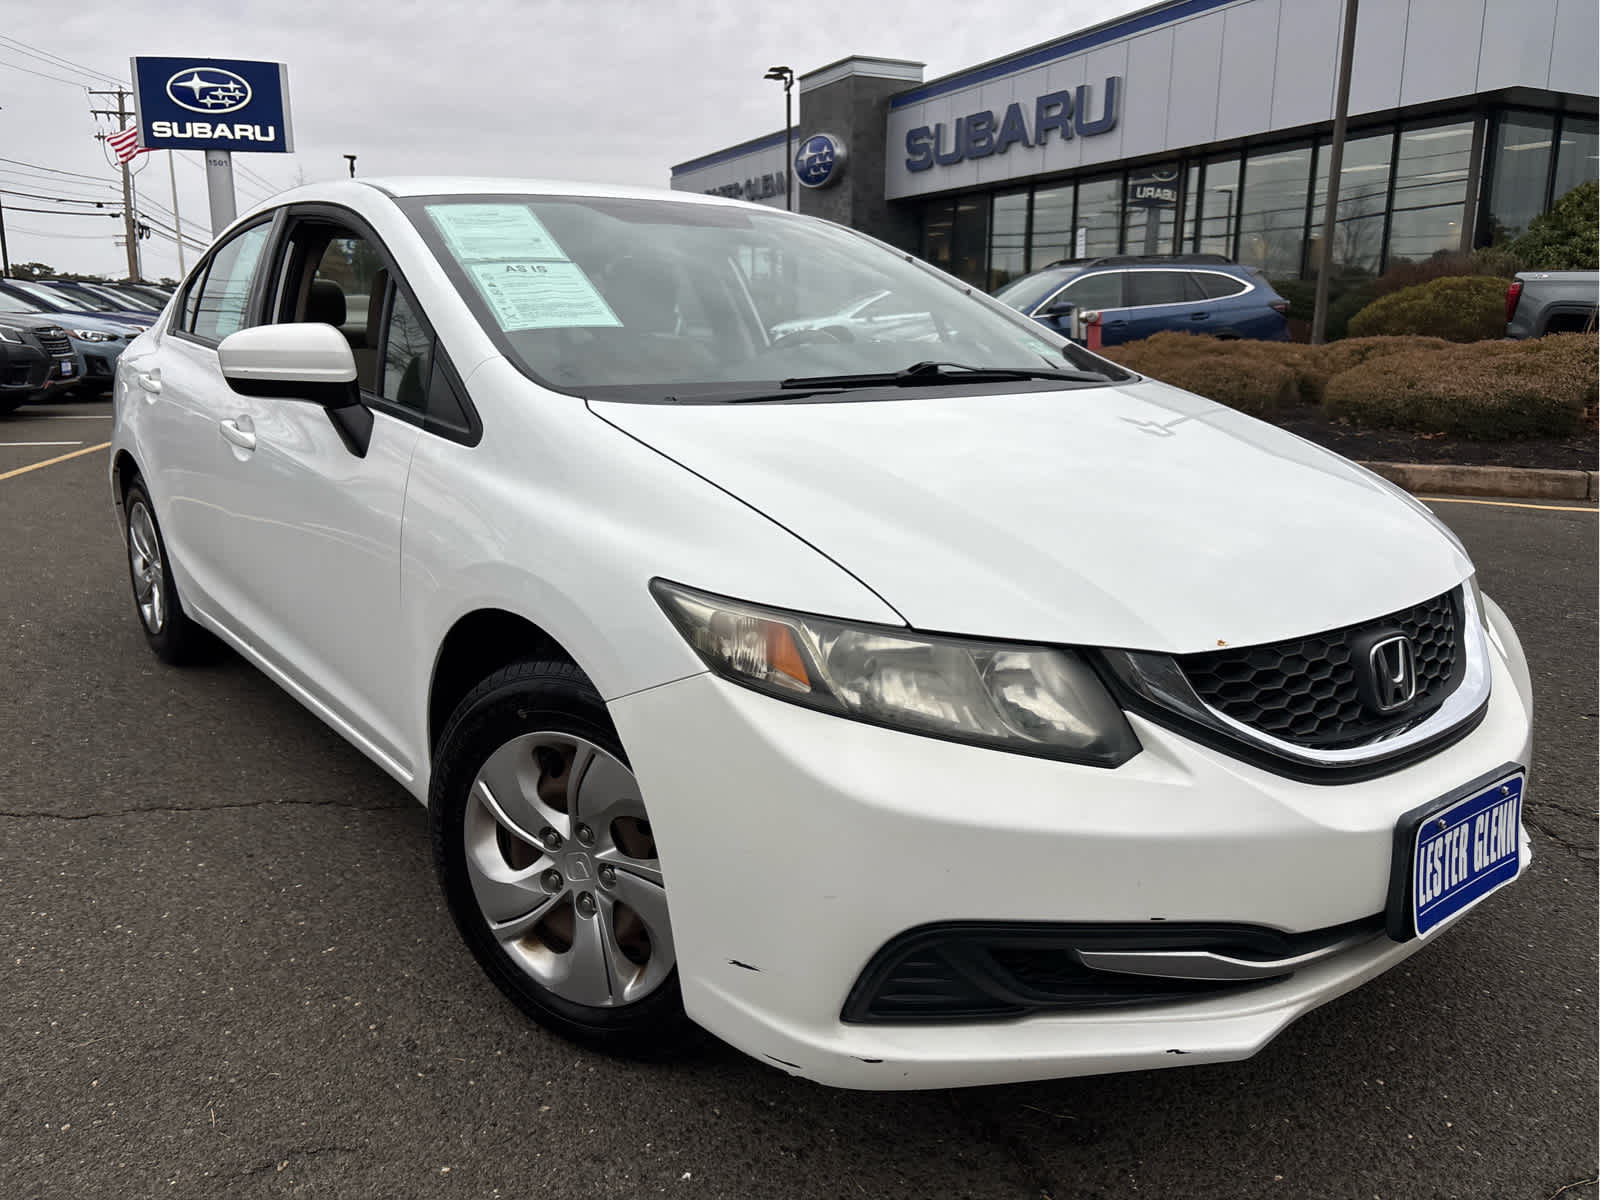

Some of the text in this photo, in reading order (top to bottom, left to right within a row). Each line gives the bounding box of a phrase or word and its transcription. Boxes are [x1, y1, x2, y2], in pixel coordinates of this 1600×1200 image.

[152, 121, 275, 141] SUBARU
[905, 76, 1121, 173] SUBARU
[208, 159, 228, 167] 1501
[505, 264, 548, 273] AS IS
[1418, 797, 1518, 908] LESTER GLENN
